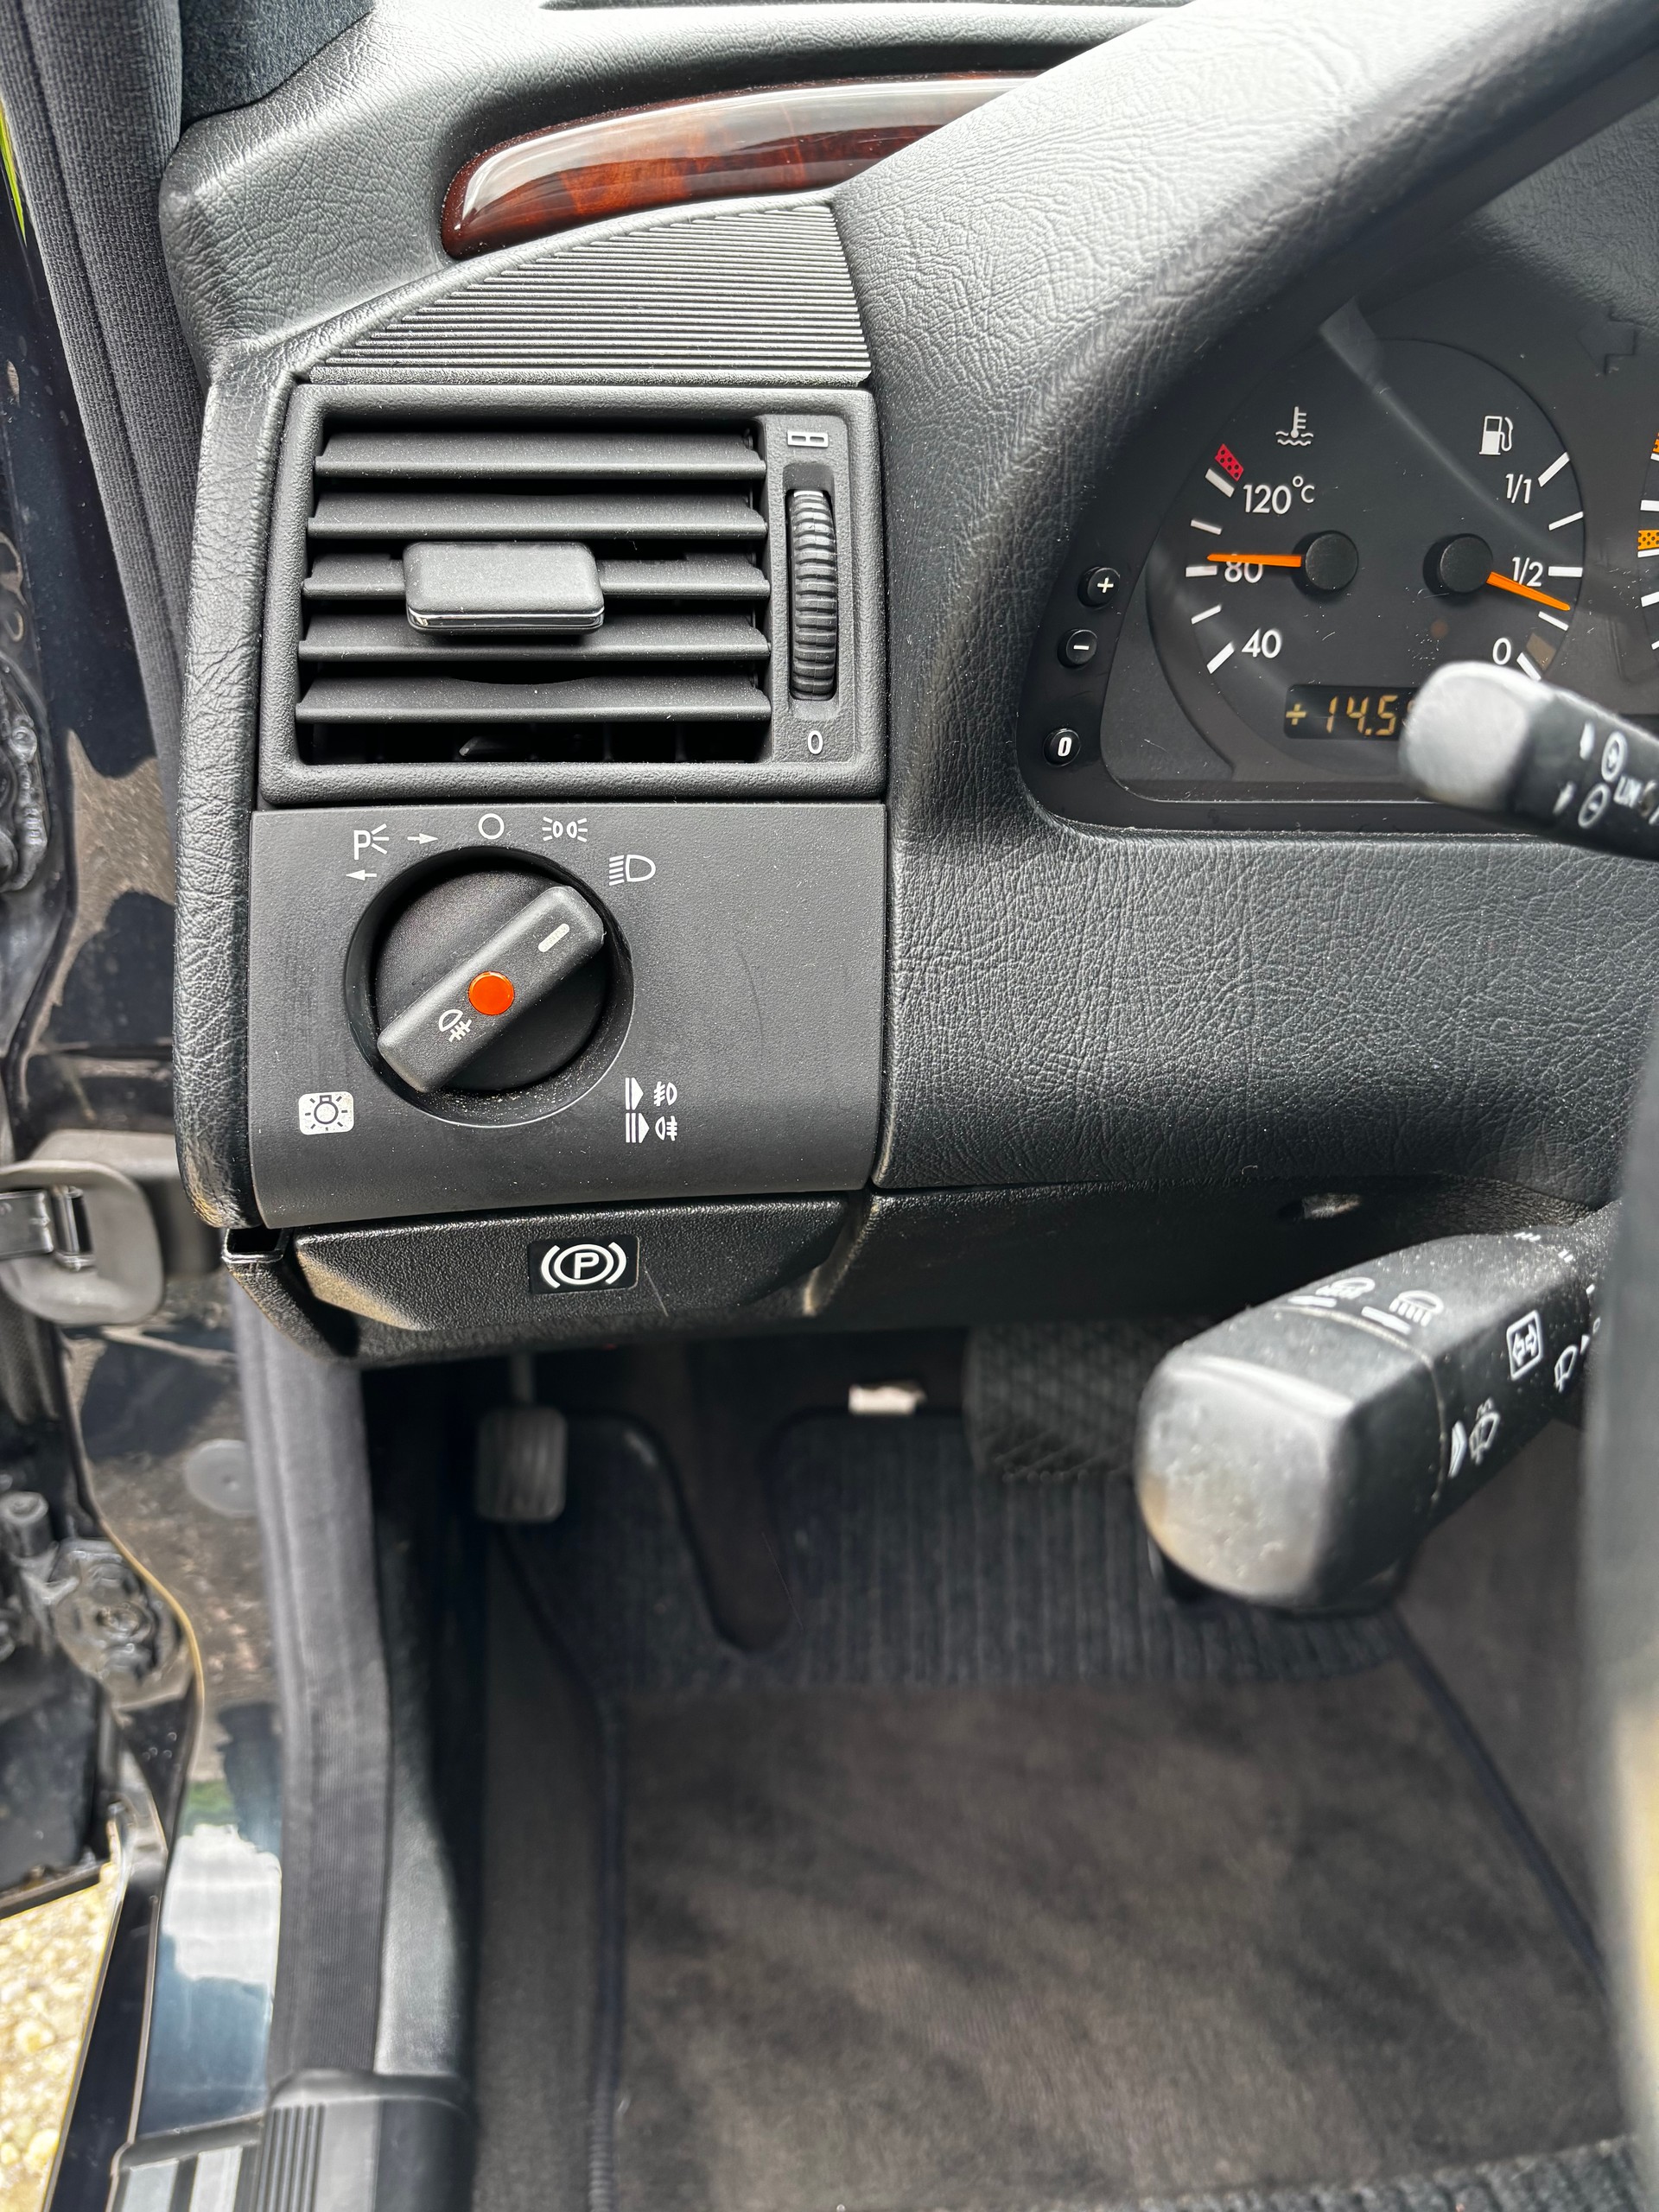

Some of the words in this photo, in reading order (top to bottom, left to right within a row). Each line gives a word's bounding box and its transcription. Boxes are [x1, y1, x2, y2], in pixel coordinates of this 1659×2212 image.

[1505, 474, 1532, 504] 1/1
[1224, 553, 1263, 583] 80
[1512, 556, 1543, 588] 1/2
[1241, 627, 1282, 658] 40
[1492, 637, 1512, 665] 0
[353, 830, 372, 861] P
[574, 1252, 600, 1279] P
